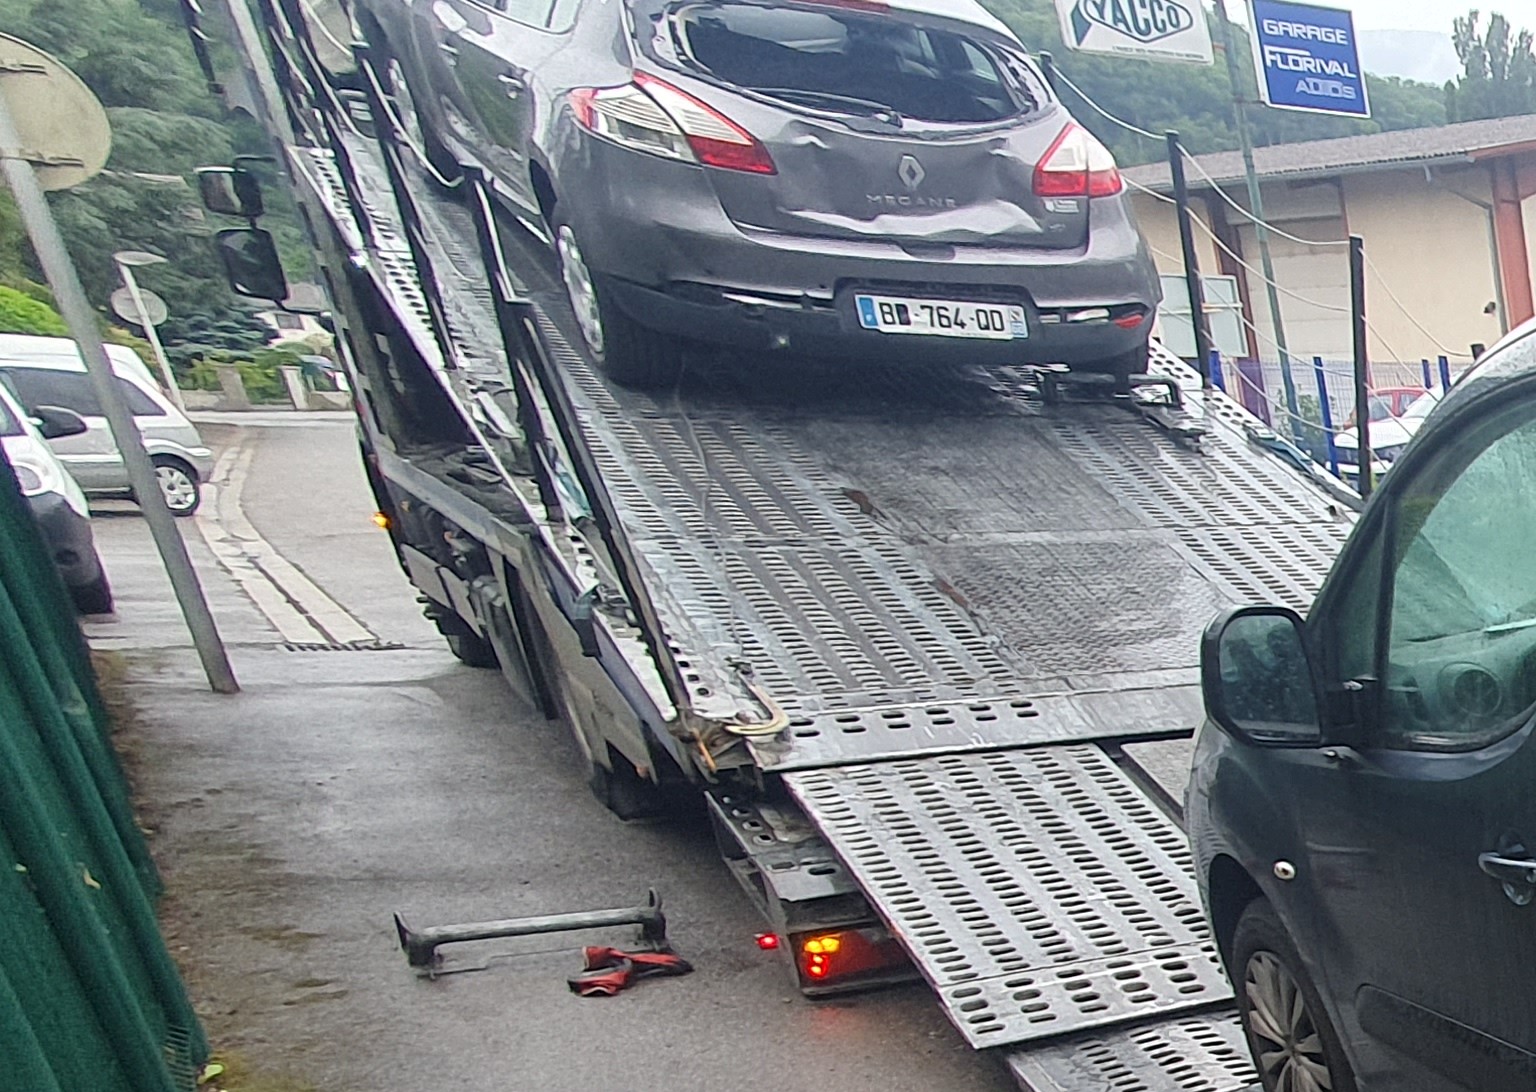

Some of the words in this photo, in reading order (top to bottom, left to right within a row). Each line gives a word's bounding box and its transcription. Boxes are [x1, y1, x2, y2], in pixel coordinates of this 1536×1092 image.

[1091, 0, 1181, 37] YACCO
[1262, 18, 1349, 45] GARAGE
[1262, 44, 1357, 78] FLORIVAL
